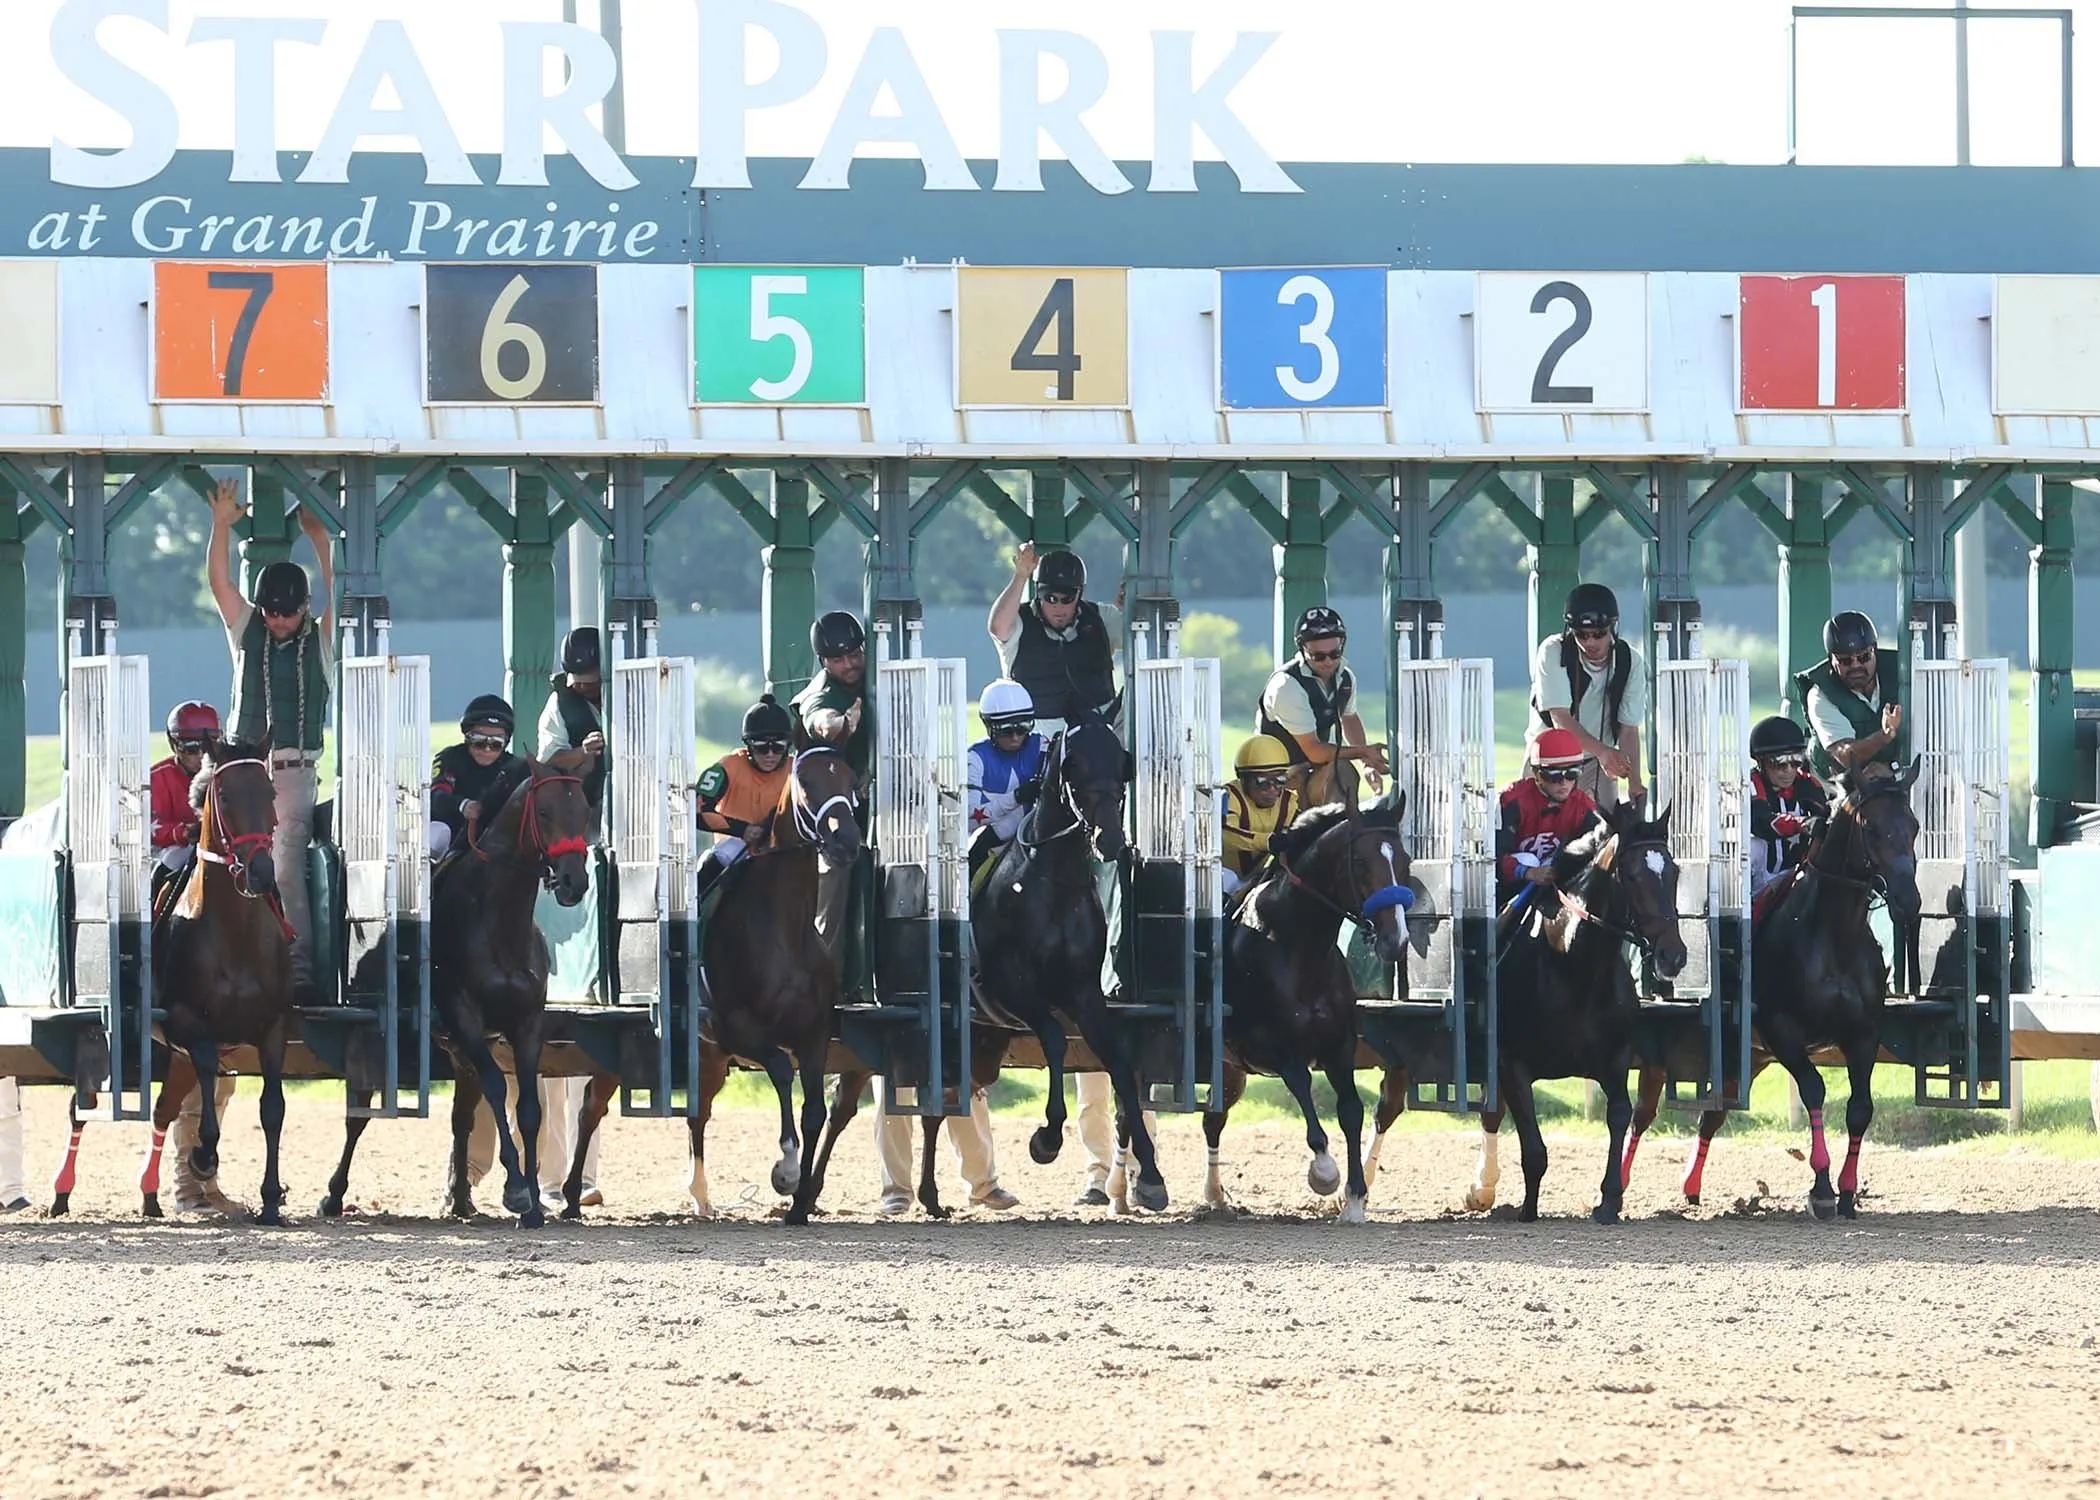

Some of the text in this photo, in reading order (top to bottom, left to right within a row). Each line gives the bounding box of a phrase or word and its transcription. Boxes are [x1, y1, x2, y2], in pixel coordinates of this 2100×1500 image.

[50, 0, 1305, 195] STAR PARK
[27, 195, 659, 258] at Grand Prairie
[207, 271, 274, 397] 7
[480, 273, 547, 400] 6
[748, 275, 813, 401] 5
[1010, 278, 1082, 401] 4
[1275, 275, 1340, 402] 3
[1529, 280, 1594, 404] 2
[1811, 283, 1837, 407] 1
[700, 770, 721, 791] 5
